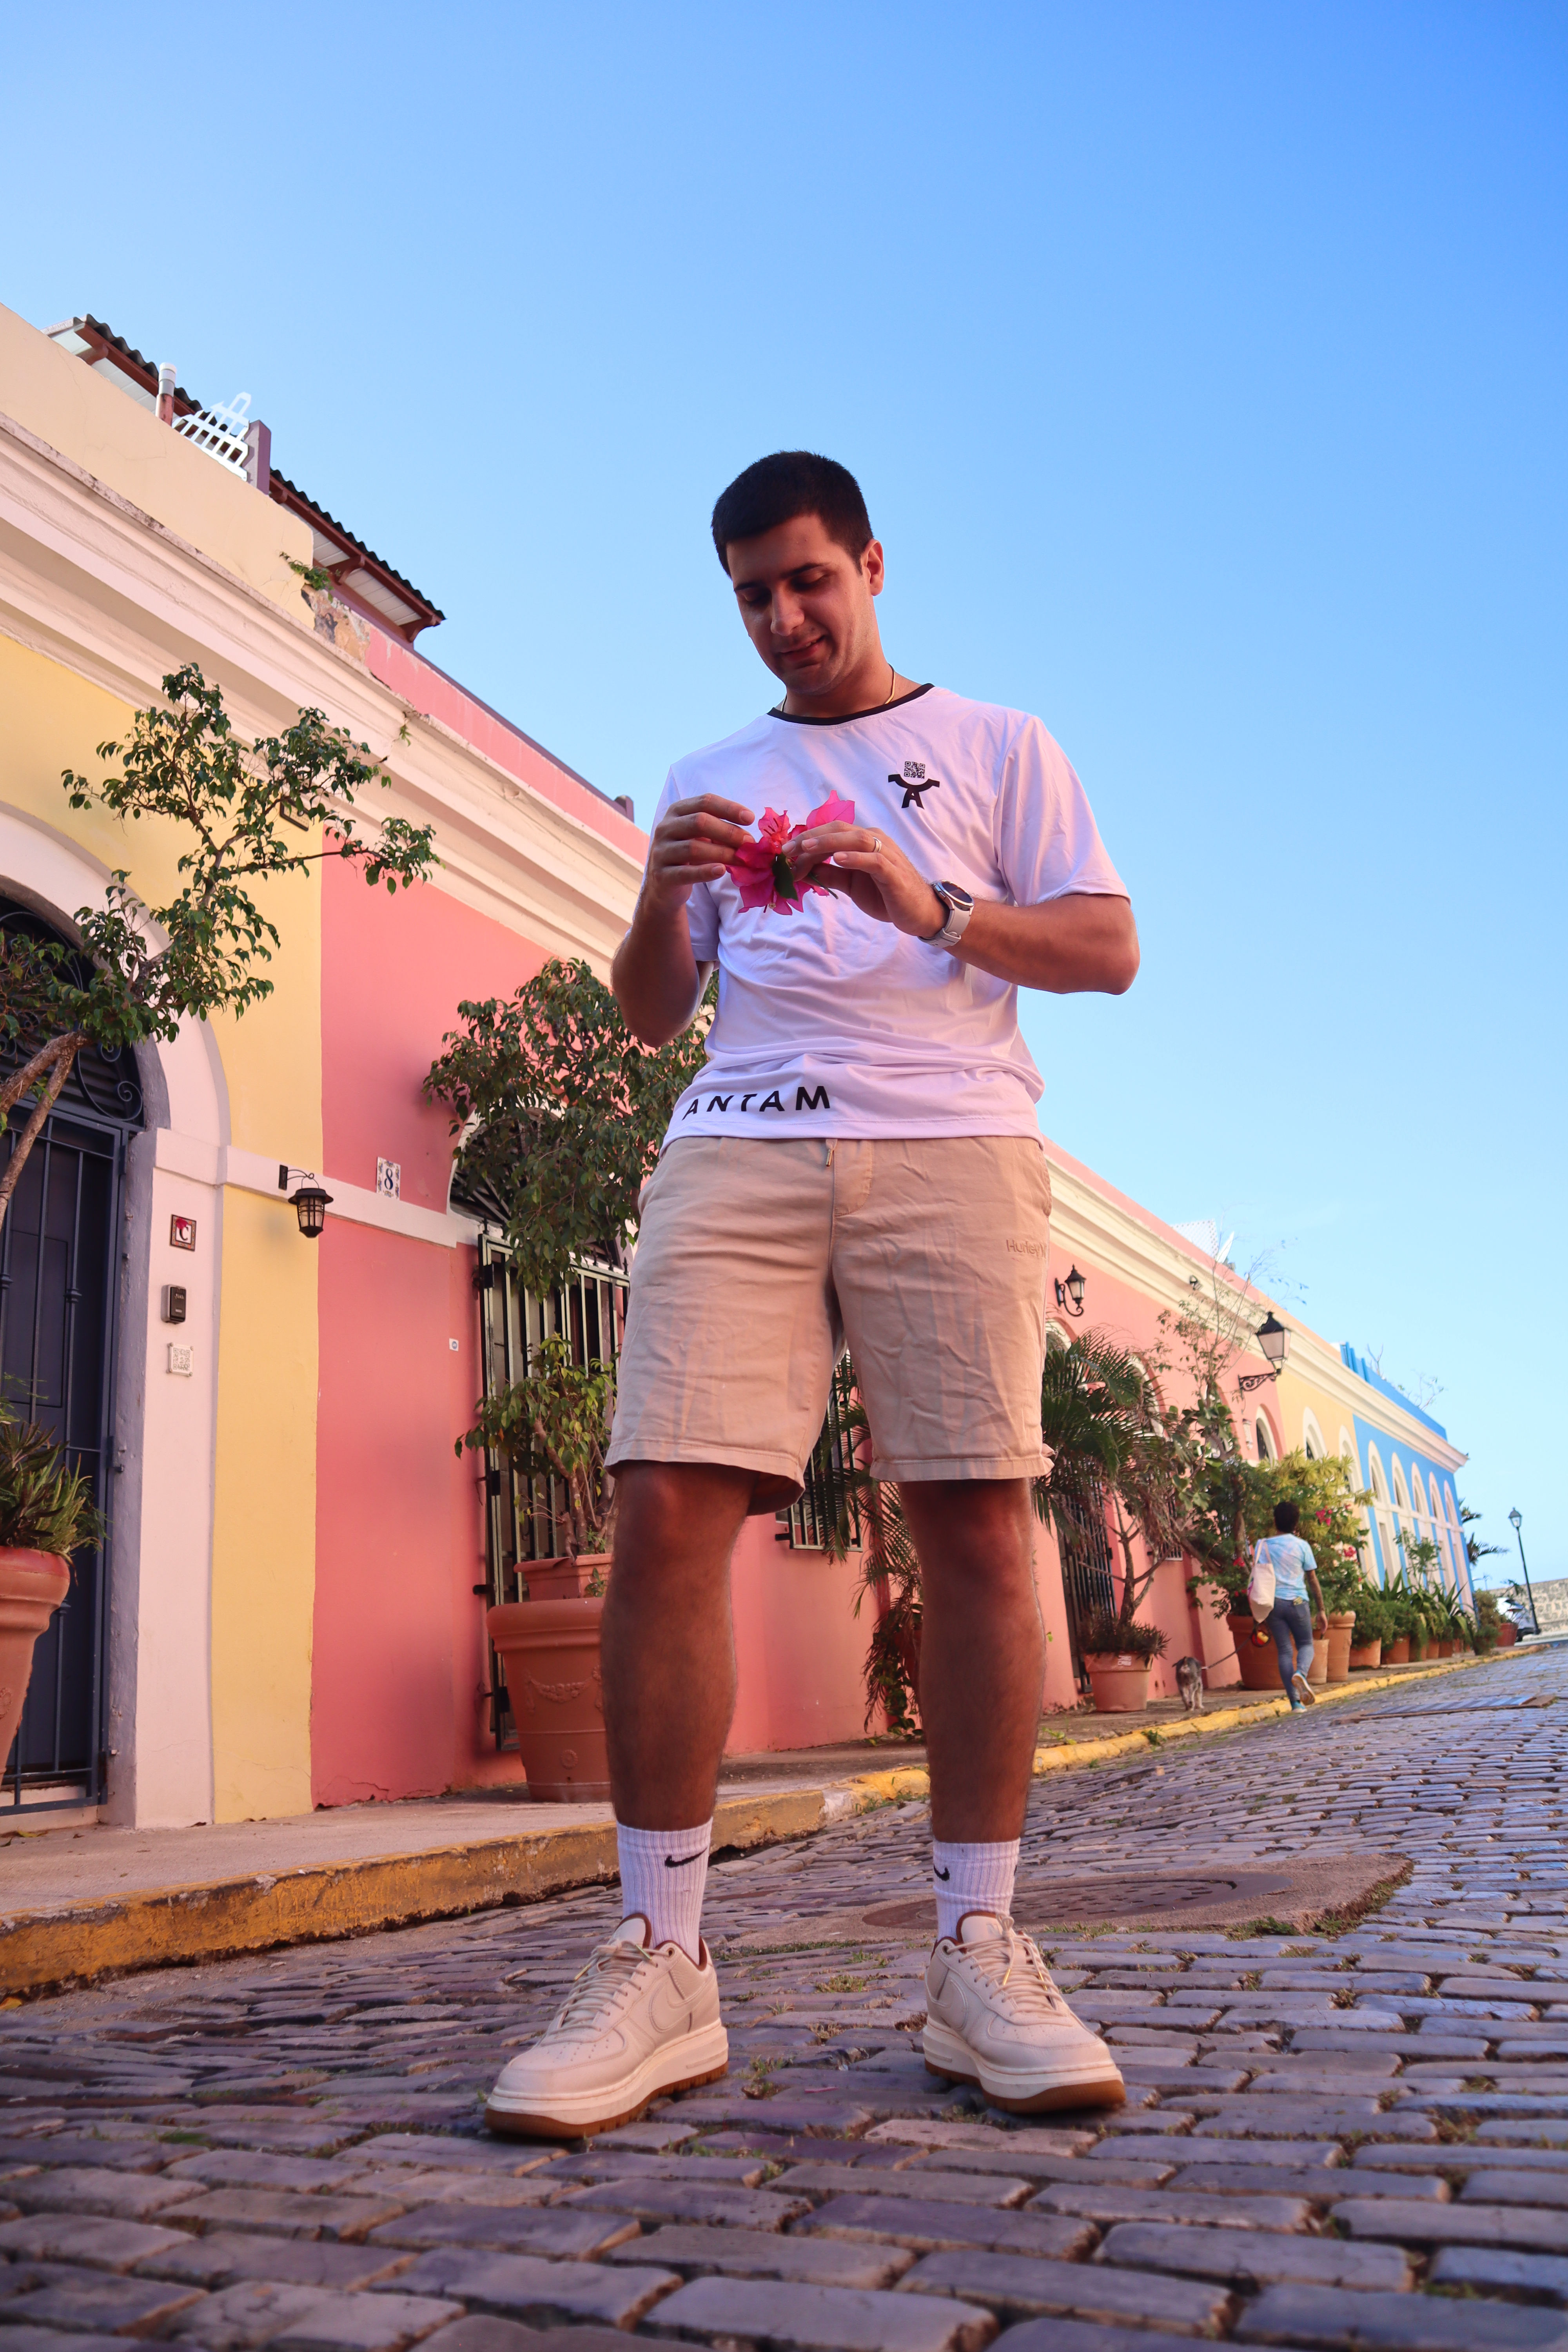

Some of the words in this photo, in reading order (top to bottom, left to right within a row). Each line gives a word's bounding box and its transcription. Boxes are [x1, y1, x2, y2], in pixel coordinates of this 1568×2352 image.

[682, 1085, 830, 1120] ANTAM
[384, 1168, 393, 1190] 8
[1006, 1239, 1039, 1257] Hurley
